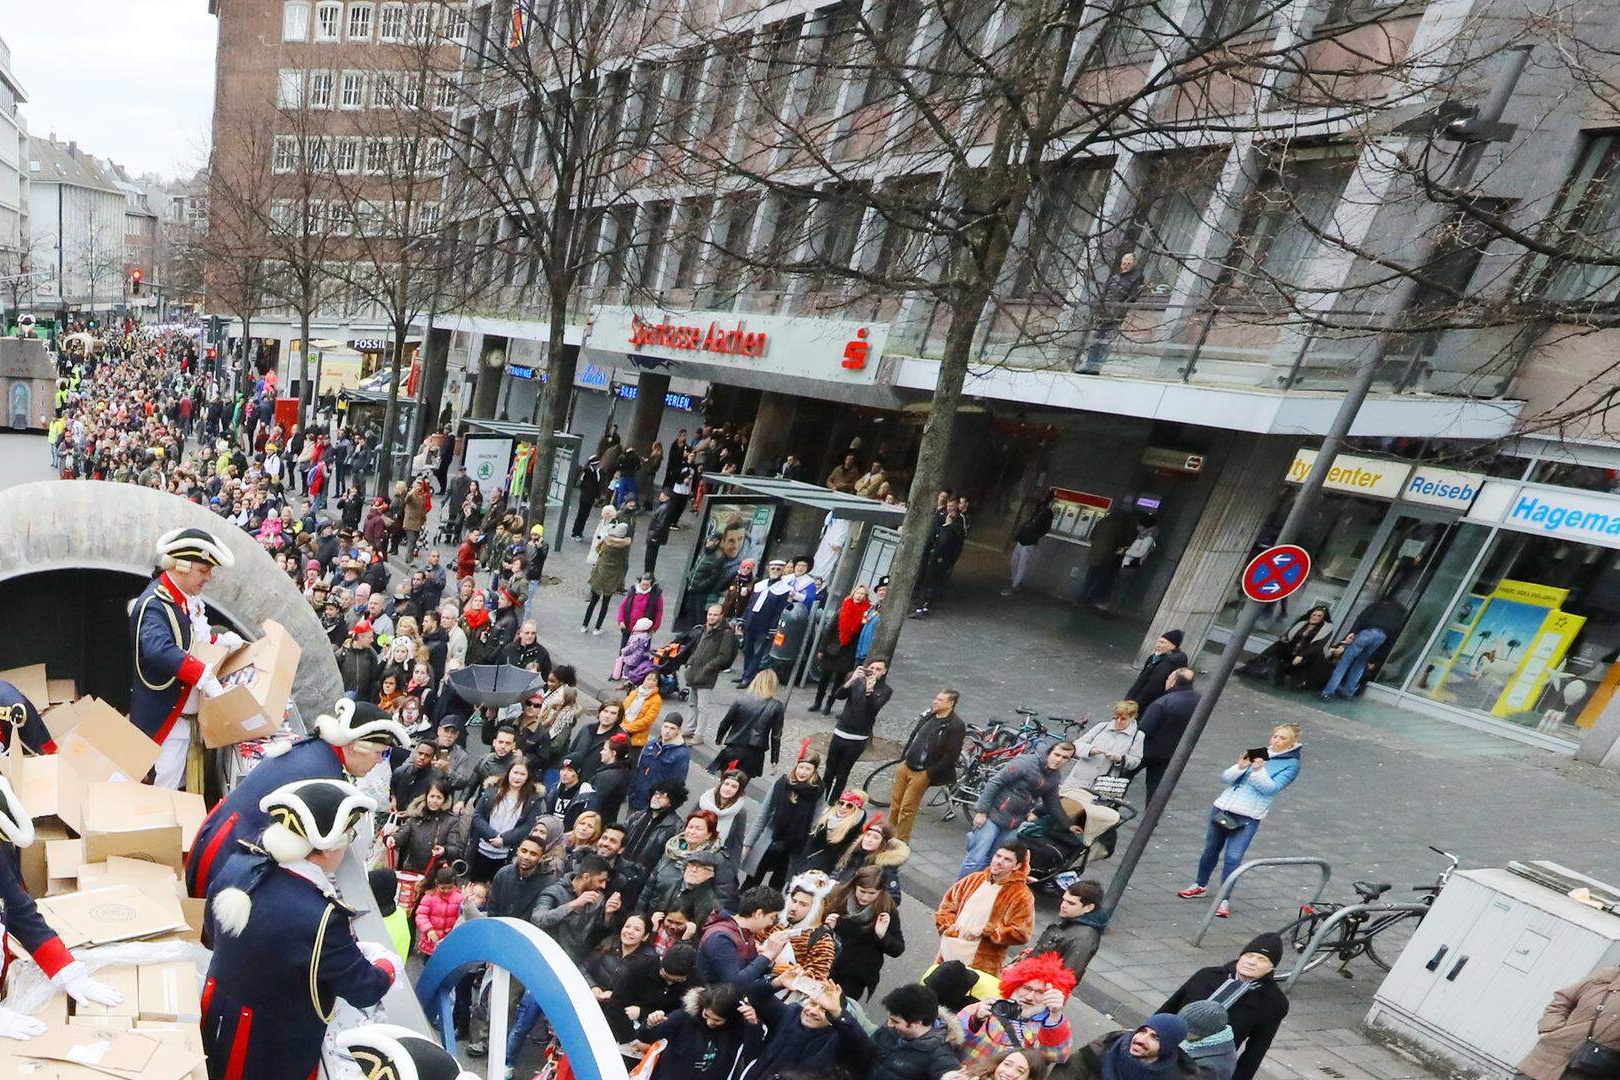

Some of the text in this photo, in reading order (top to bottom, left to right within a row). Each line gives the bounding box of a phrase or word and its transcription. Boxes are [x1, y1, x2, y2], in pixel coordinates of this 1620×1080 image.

[353, 339, 386, 349] FOSSIL
[628, 314, 768, 358] Sparkasse Aachen
